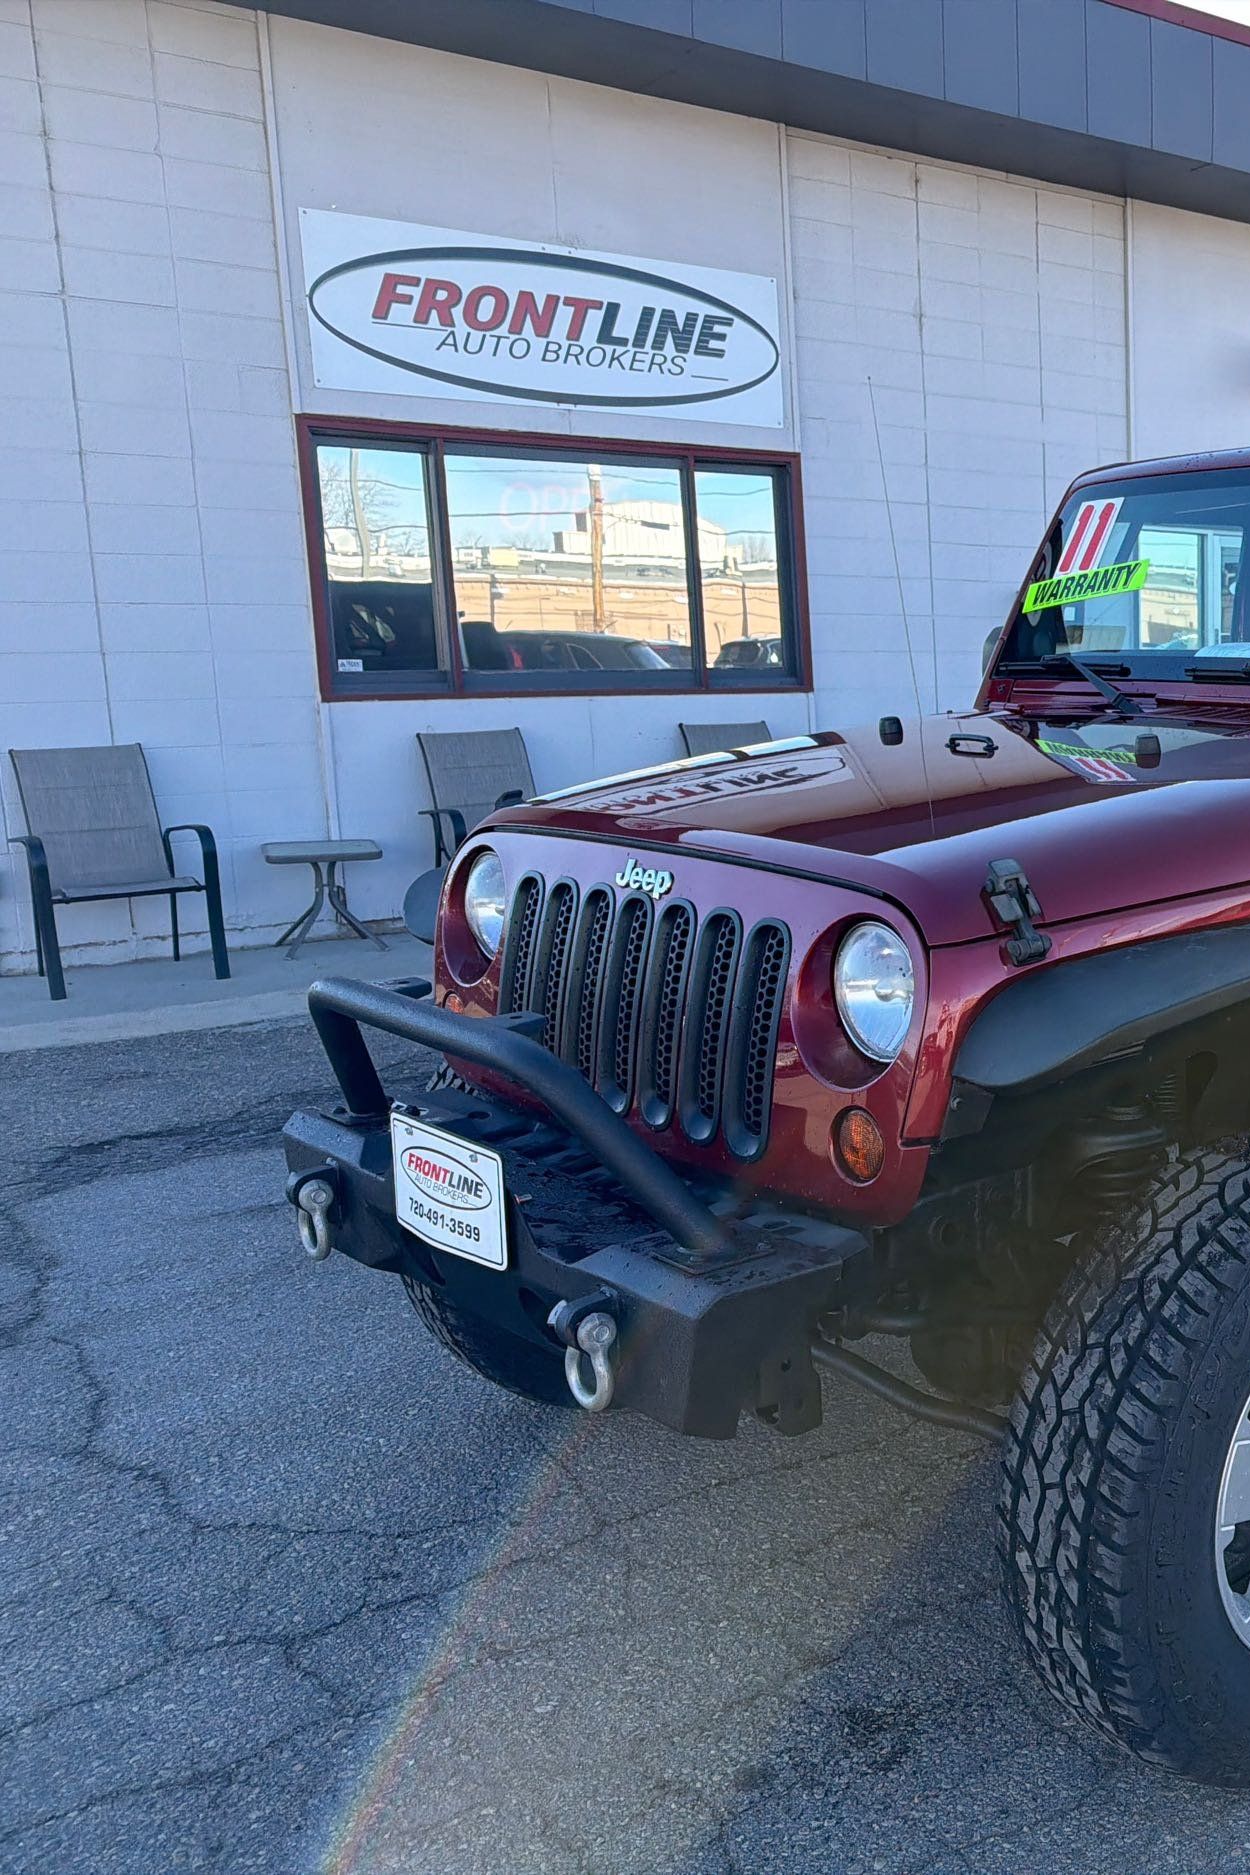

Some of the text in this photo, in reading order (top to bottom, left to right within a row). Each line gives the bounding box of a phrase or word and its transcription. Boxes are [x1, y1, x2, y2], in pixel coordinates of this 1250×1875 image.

[371, 272, 735, 359] FRONTLINE
[436, 330, 687, 377] AUTO BROKERS
[1058, 502, 1116, 573] 11
[1032, 562, 1142, 606] WARRANTY
[615, 858, 674, 900] Jeep
[407, 1152, 484, 1200] FRONTLINE
[414, 1173, 469, 1204] AUTO BROKERS
[408, 1196, 481, 1243] 720-491-3599
